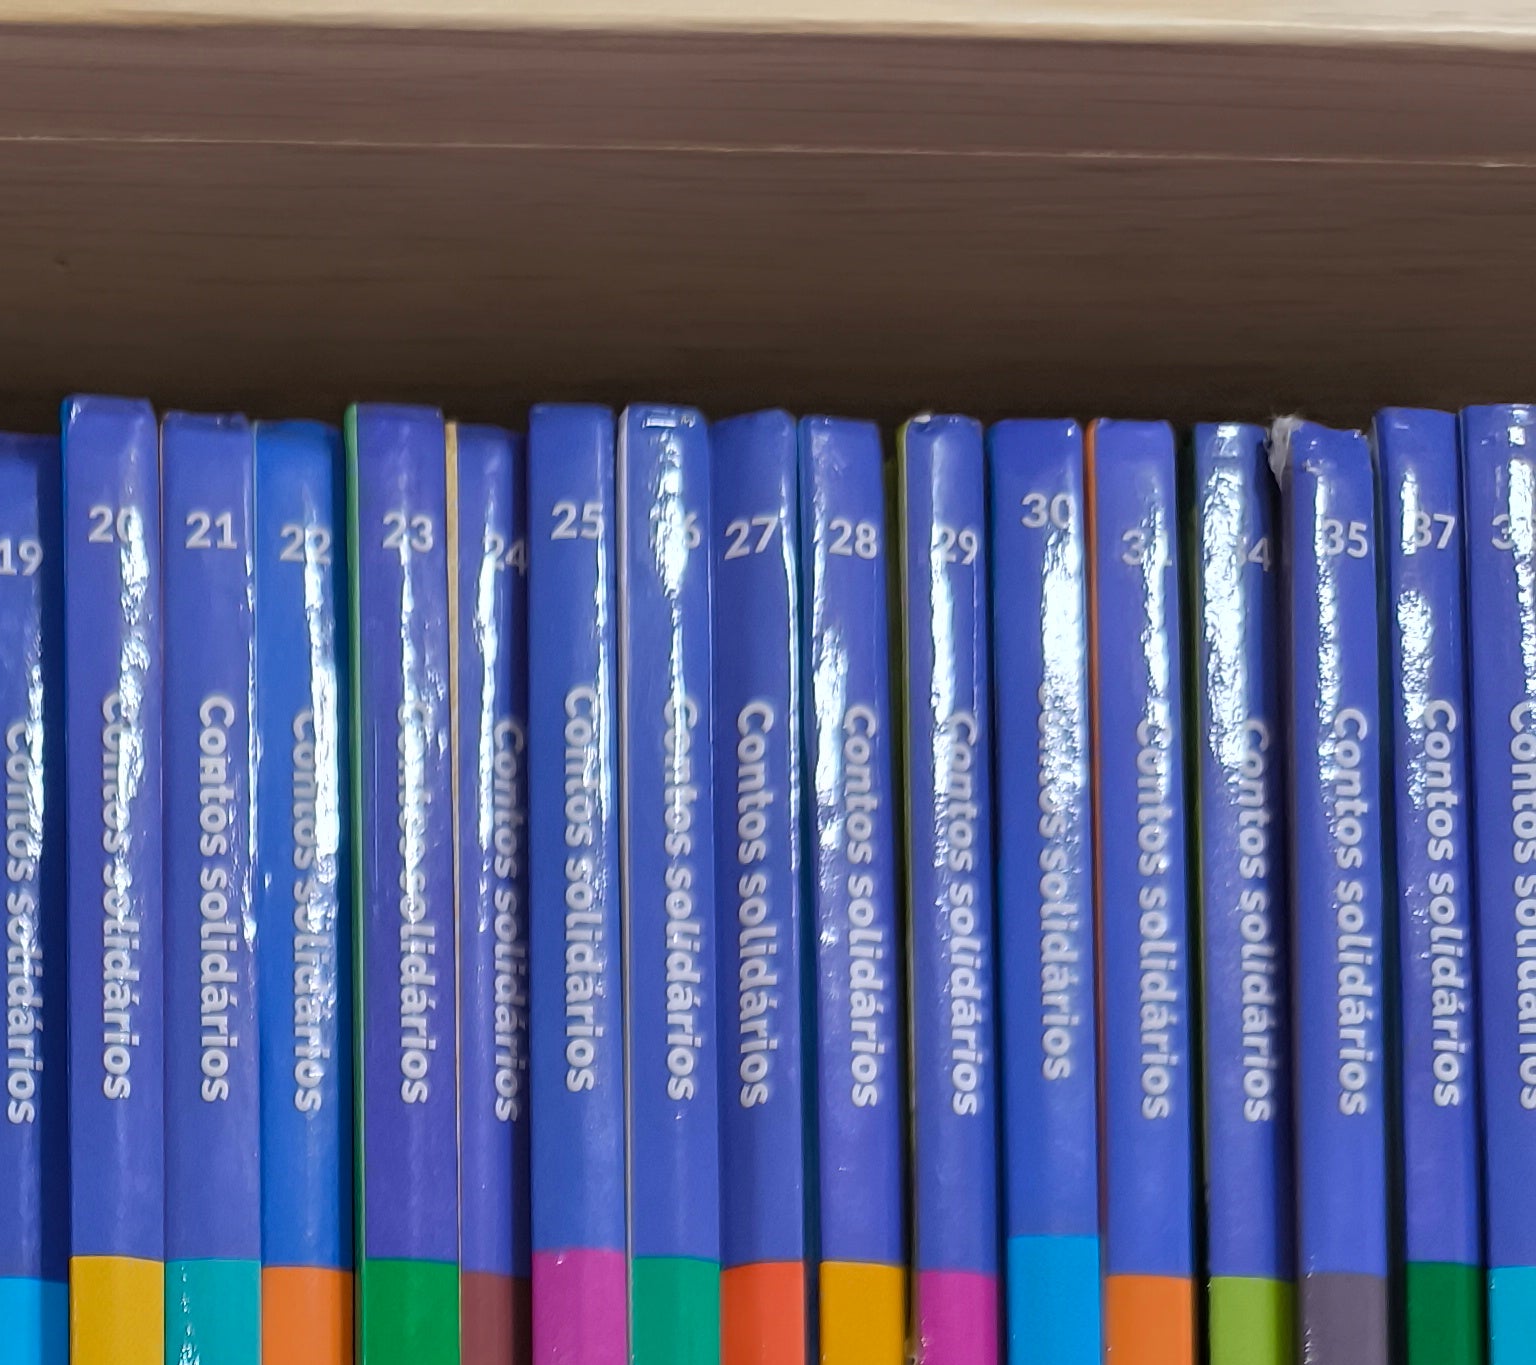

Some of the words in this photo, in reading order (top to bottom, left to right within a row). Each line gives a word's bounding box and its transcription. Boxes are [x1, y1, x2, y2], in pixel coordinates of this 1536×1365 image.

[185, 512, 237, 549] 21
[279, 526, 331, 564] 22
[382, 512, 433, 551] 23
[551, 503, 604, 539] 25
[724, 517, 778, 560] 27
[829, 520, 877, 559] 28
[936, 528, 977, 564] 29
[1021, 494, 1071, 529] 30
[1323, 519, 1368, 559] 35
[199, 697, 236, 857] Contos
[494, 719, 524, 880] Contos
[737, 703, 775, 865] Contos
[843, 705, 879, 865] Contos
[943, 710, 977, 872] Contos
[1334, 709, 1370, 869] Contos
[1424, 700, 1458, 861] Contos
[200, 867, 239, 1102] solidários
[494, 889, 527, 1122] solidários
[565, 856, 604, 1092] solidários
[665, 866, 700, 1101] solidários
[738, 873, 778, 1108] solidários
[847, 875, 885, 1108] solidários
[950, 882, 986, 1116] solidários
[1139, 886, 1177, 1122] solidários
[1239, 889, 1276, 1123] solidários
[1337, 879, 1374, 1117] solidários
[1429, 872, 1465, 1107] solidários
